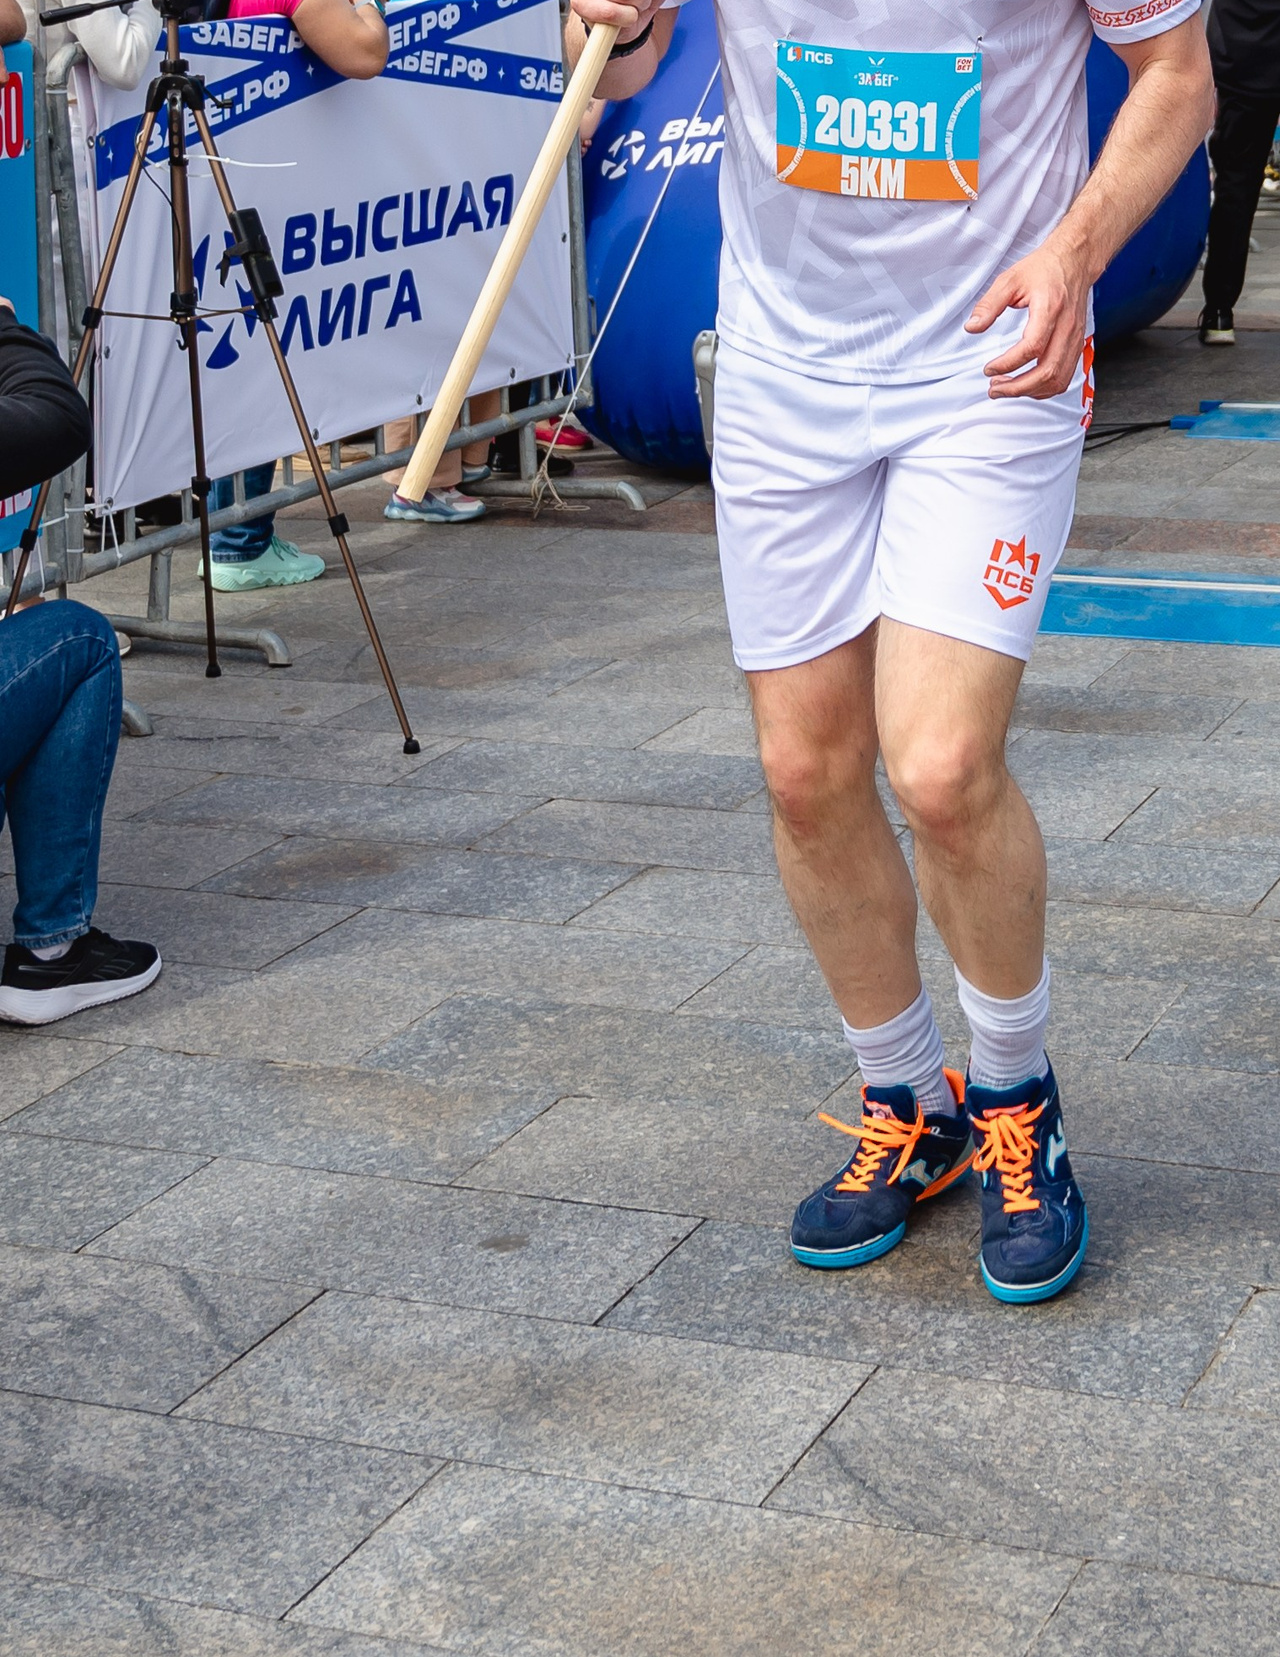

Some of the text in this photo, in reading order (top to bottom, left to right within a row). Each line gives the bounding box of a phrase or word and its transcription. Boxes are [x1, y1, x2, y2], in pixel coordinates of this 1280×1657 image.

[191, 21, 306, 54] ЗАБЕГ.Р
[388, 2, 461, 52] ЕГ.РФ
[804, 49, 834, 66] ПСБ
[147, 69, 291, 155] ЗБЕГ.РФ
[814, 94, 938, 153] 20331
[645, 140, 726, 172] ЛИГ
[281, 173, 516, 276] ВЫСШАЯ
[279, 268, 424, 357] ЛИГА
[983, 563, 1035, 595] ПСБ
